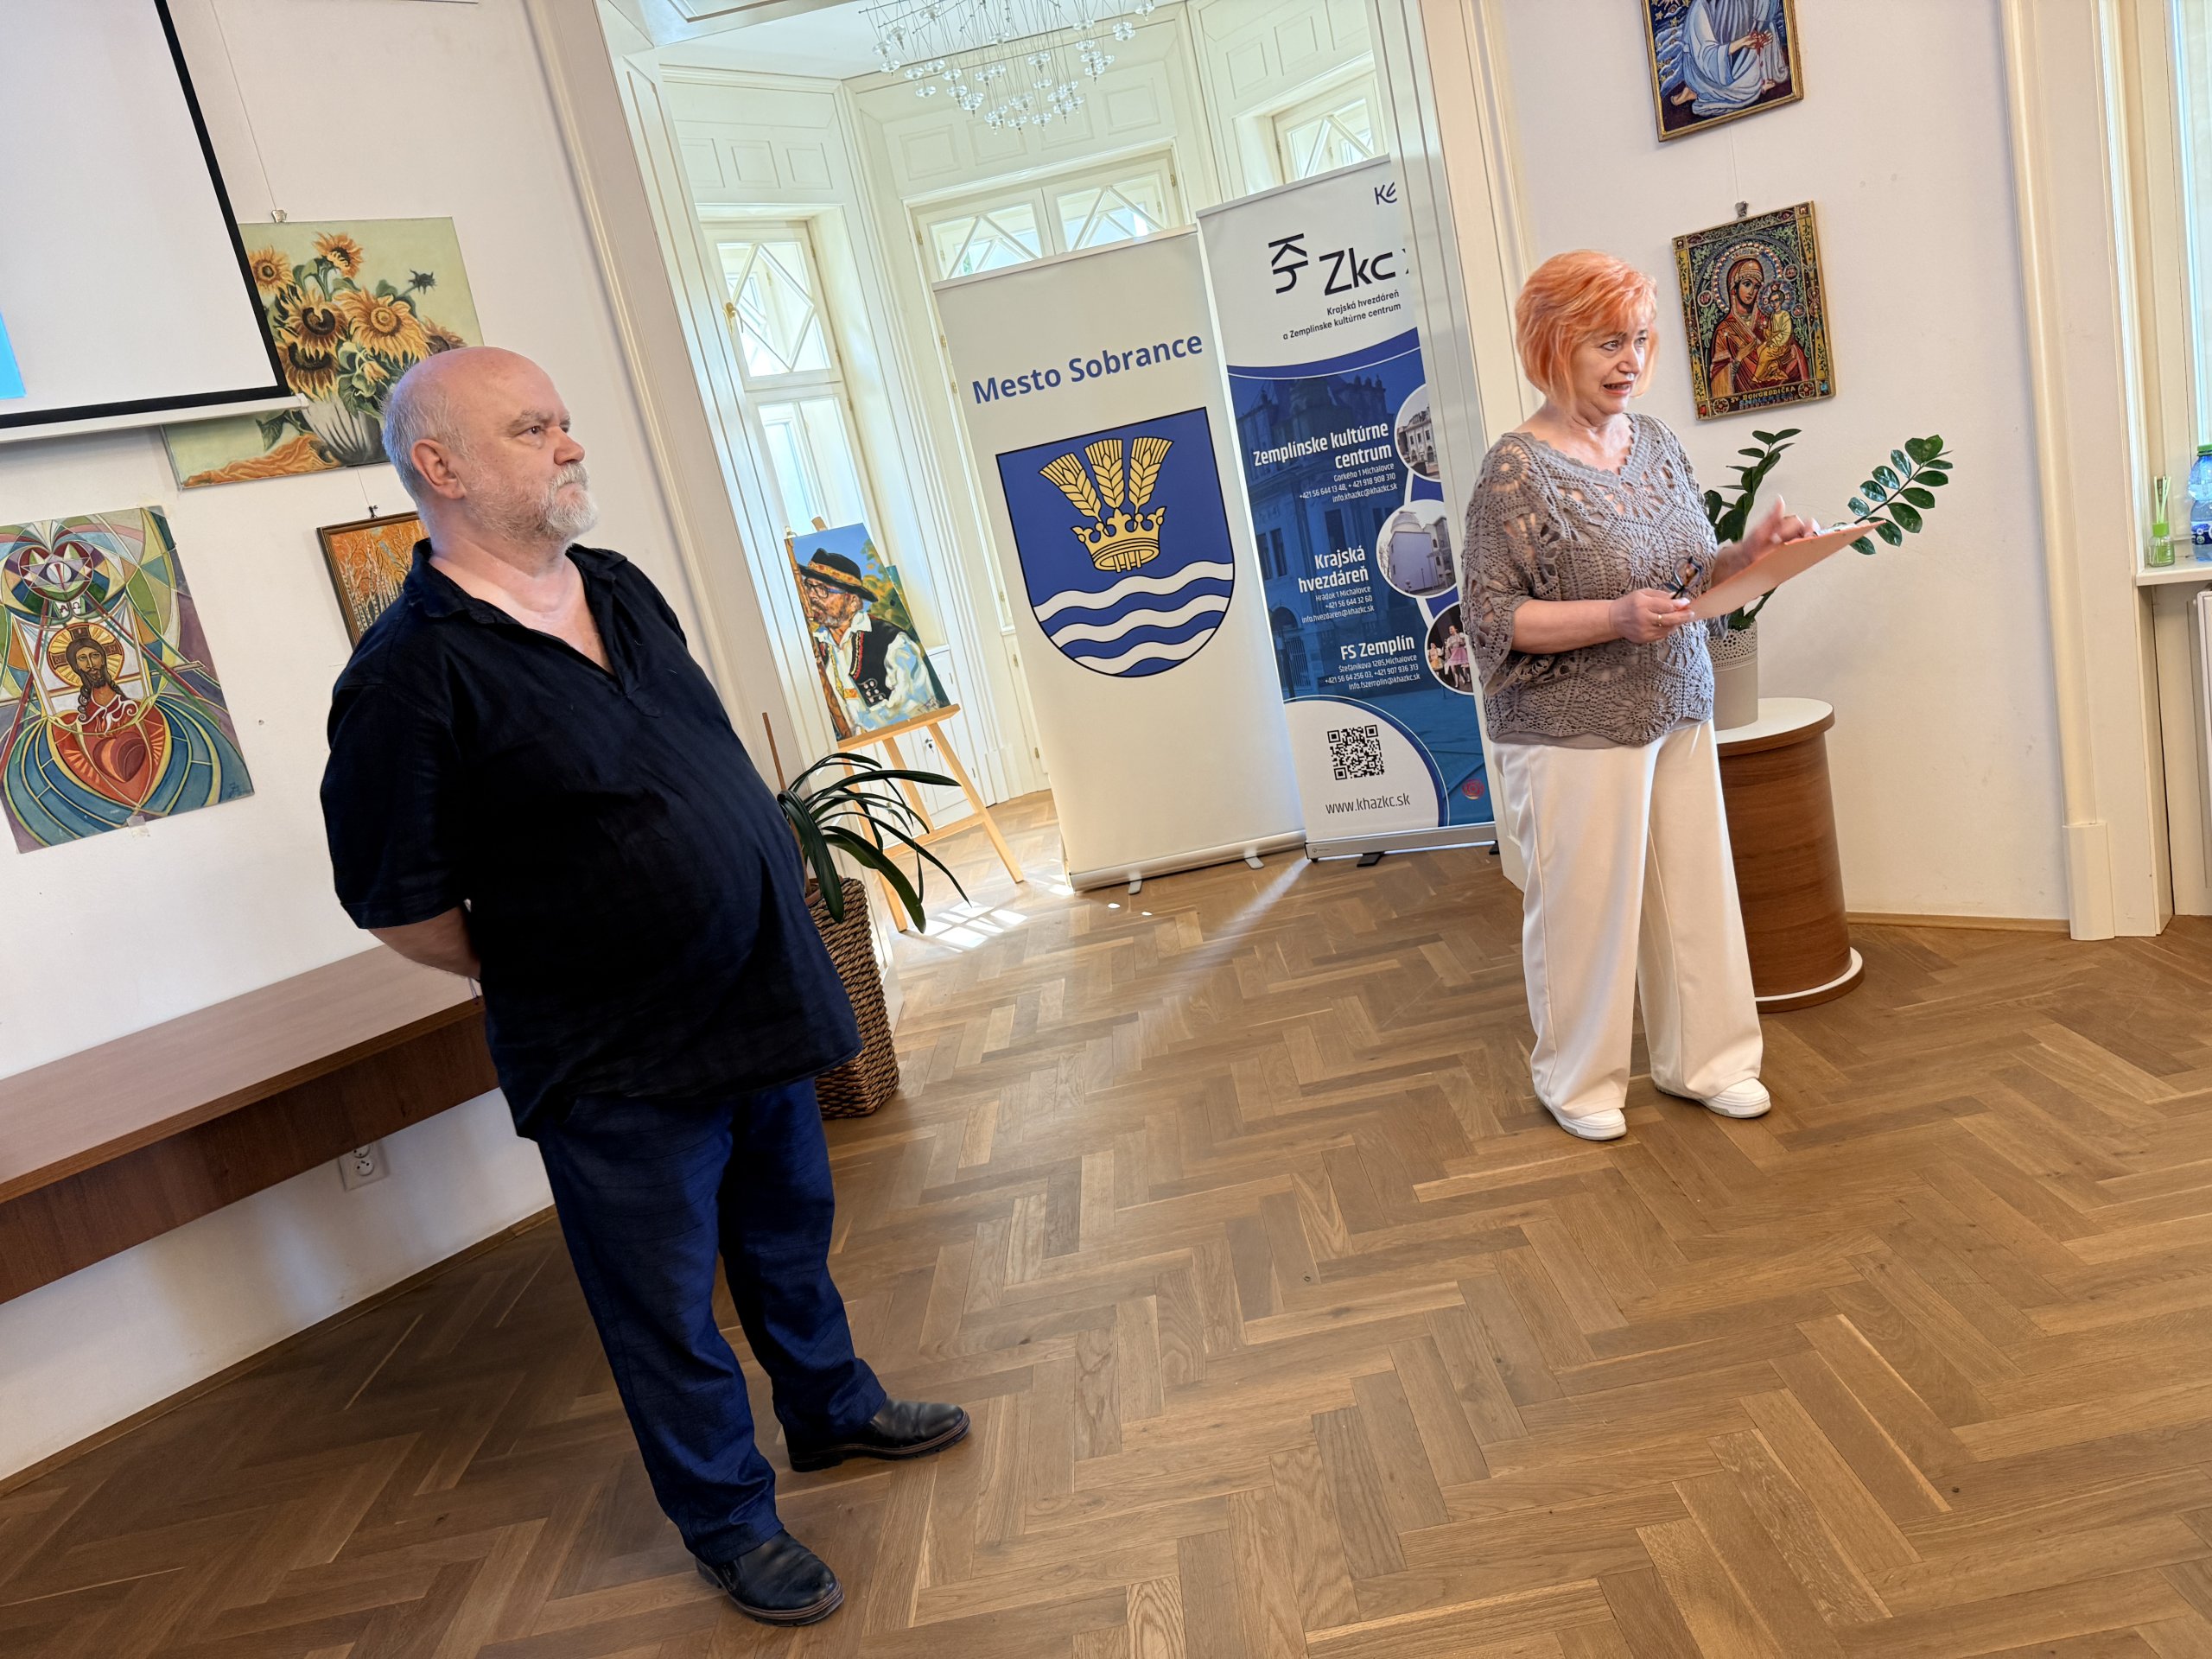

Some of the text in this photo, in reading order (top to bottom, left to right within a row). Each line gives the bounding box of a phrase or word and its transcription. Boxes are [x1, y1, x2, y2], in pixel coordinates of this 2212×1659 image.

[1326, 289, 1400, 315] Krajská hvezdáreň
[1334, 313, 1366, 327] kultúrne
[1368, 303, 1402, 317] centrum
[972, 335, 1203, 404] Mesto Sobrance
[1253, 423, 1389, 467] Zemplínske kultúrne
[1335, 444, 1393, 469] centrum
[1333, 472, 1357, 482] Gorkého
[1362, 462, 1395, 475] Michalovce
[1374, 475, 1385, 484] 908
[1386, 473, 1396, 481] 310
[1332, 482, 1398, 503] info.khazkc@khazkc.sk
[1314, 544, 1365, 569] Krajská
[1298, 565, 1369, 594] hvezdáreň
[1315, 593, 1335, 602] Hrádok
[1340, 586, 1371, 598] Michalovce
[1346, 598, 1357, 607] 644
[1301, 604, 1375, 624] info.hvezdaren@khazkc.sk
[1340, 634, 1415, 660] FS Zemplín
[1353, 671, 1364, 680] 256
[1325, 792, 1411, 814] www.khazkc.sk
